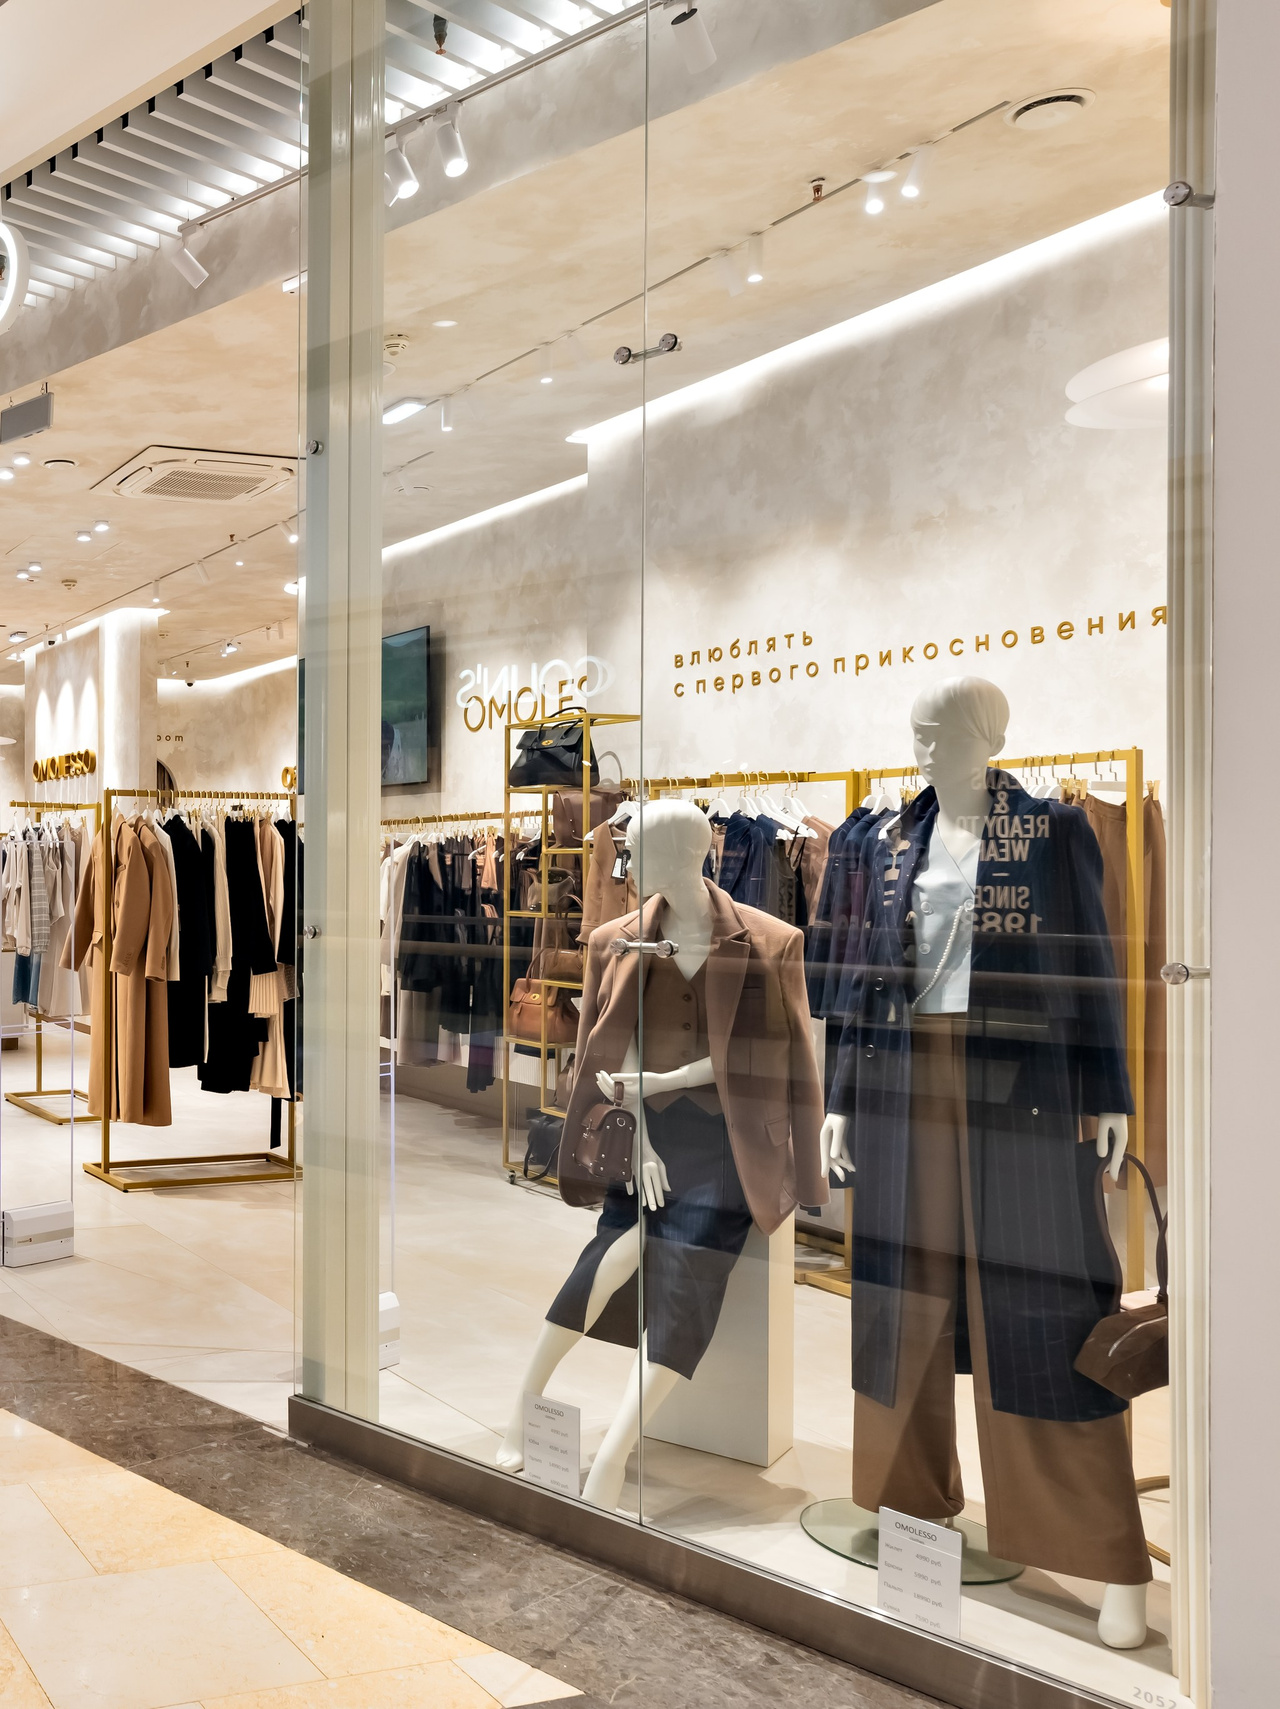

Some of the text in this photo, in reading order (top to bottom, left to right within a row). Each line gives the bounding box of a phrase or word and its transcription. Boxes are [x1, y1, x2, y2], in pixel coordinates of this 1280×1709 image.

[674, 630, 813, 669] влюблять
[674, 605, 1168, 697] с первого прикосновения
[32, 749, 96, 782] OMOLESSO
[534, 1403, 565, 1417] OMOLESSO
[894, 1521, 938, 1542] OMOLESSO
[1132, 1686, 1177, 1709] 2052
